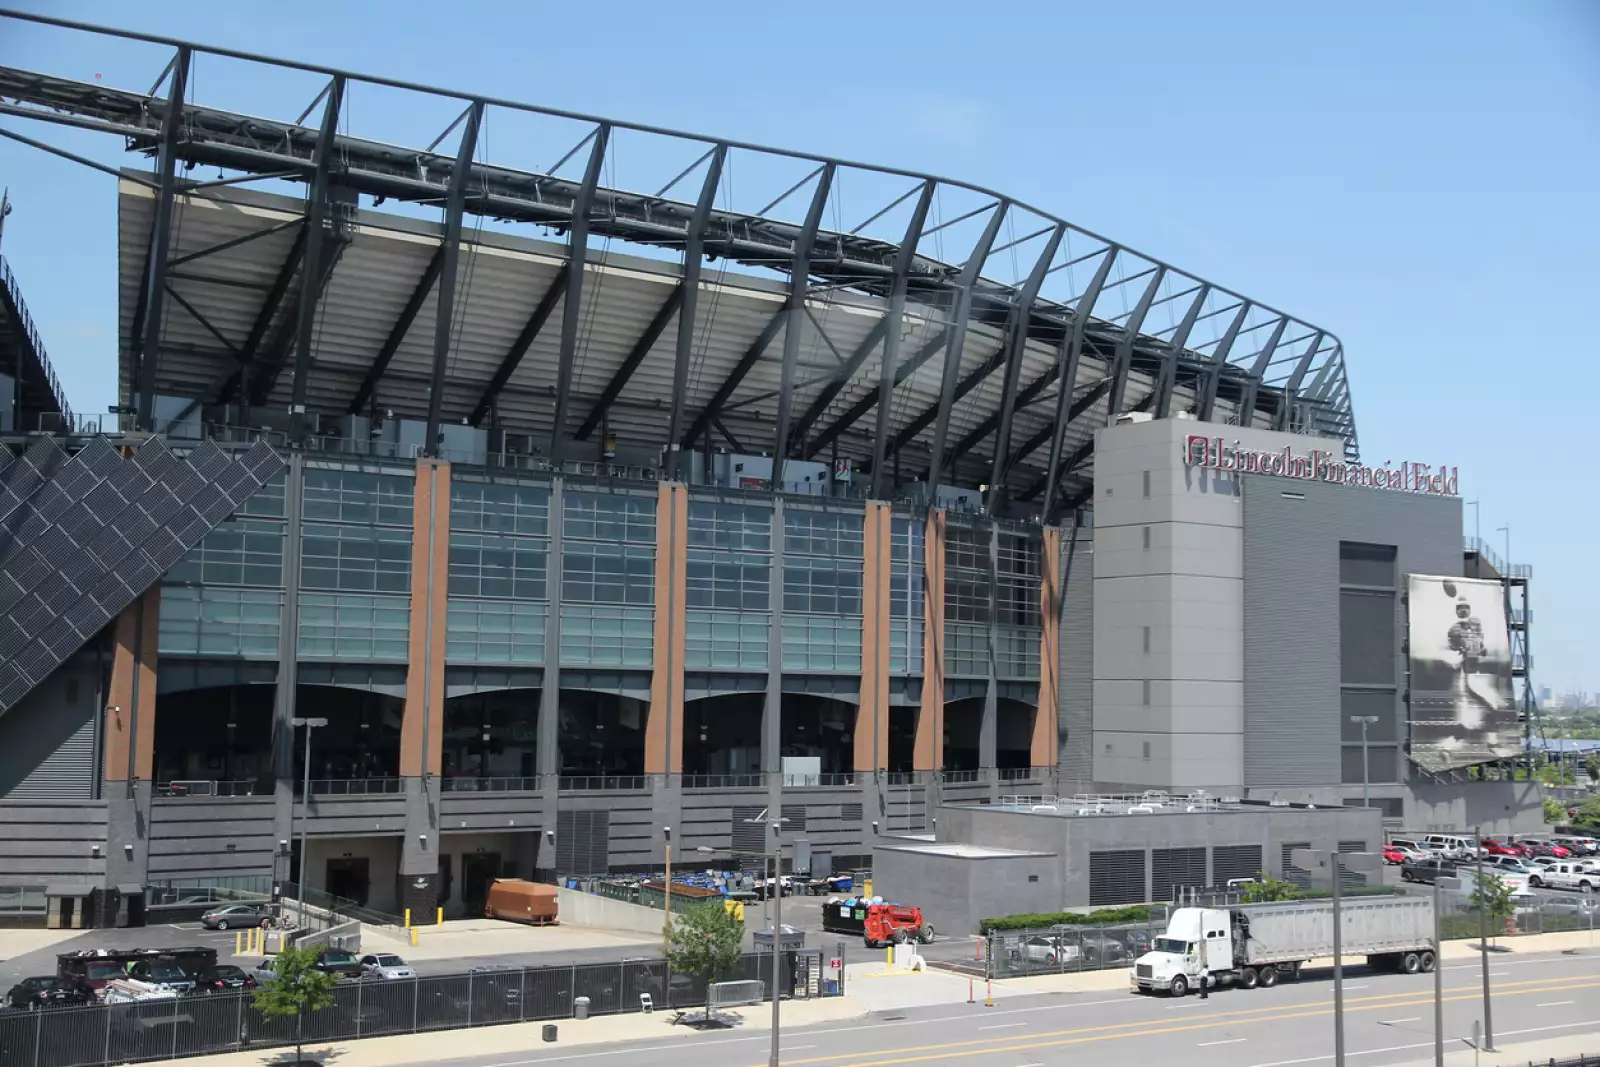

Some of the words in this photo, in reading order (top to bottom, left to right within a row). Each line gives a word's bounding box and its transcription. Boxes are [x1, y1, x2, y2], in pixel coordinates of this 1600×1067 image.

[1213, 437, 1307, 477] Lincoln
[1309, 449, 1408, 491] Financial
[1410, 462, 1459, 495] Field
